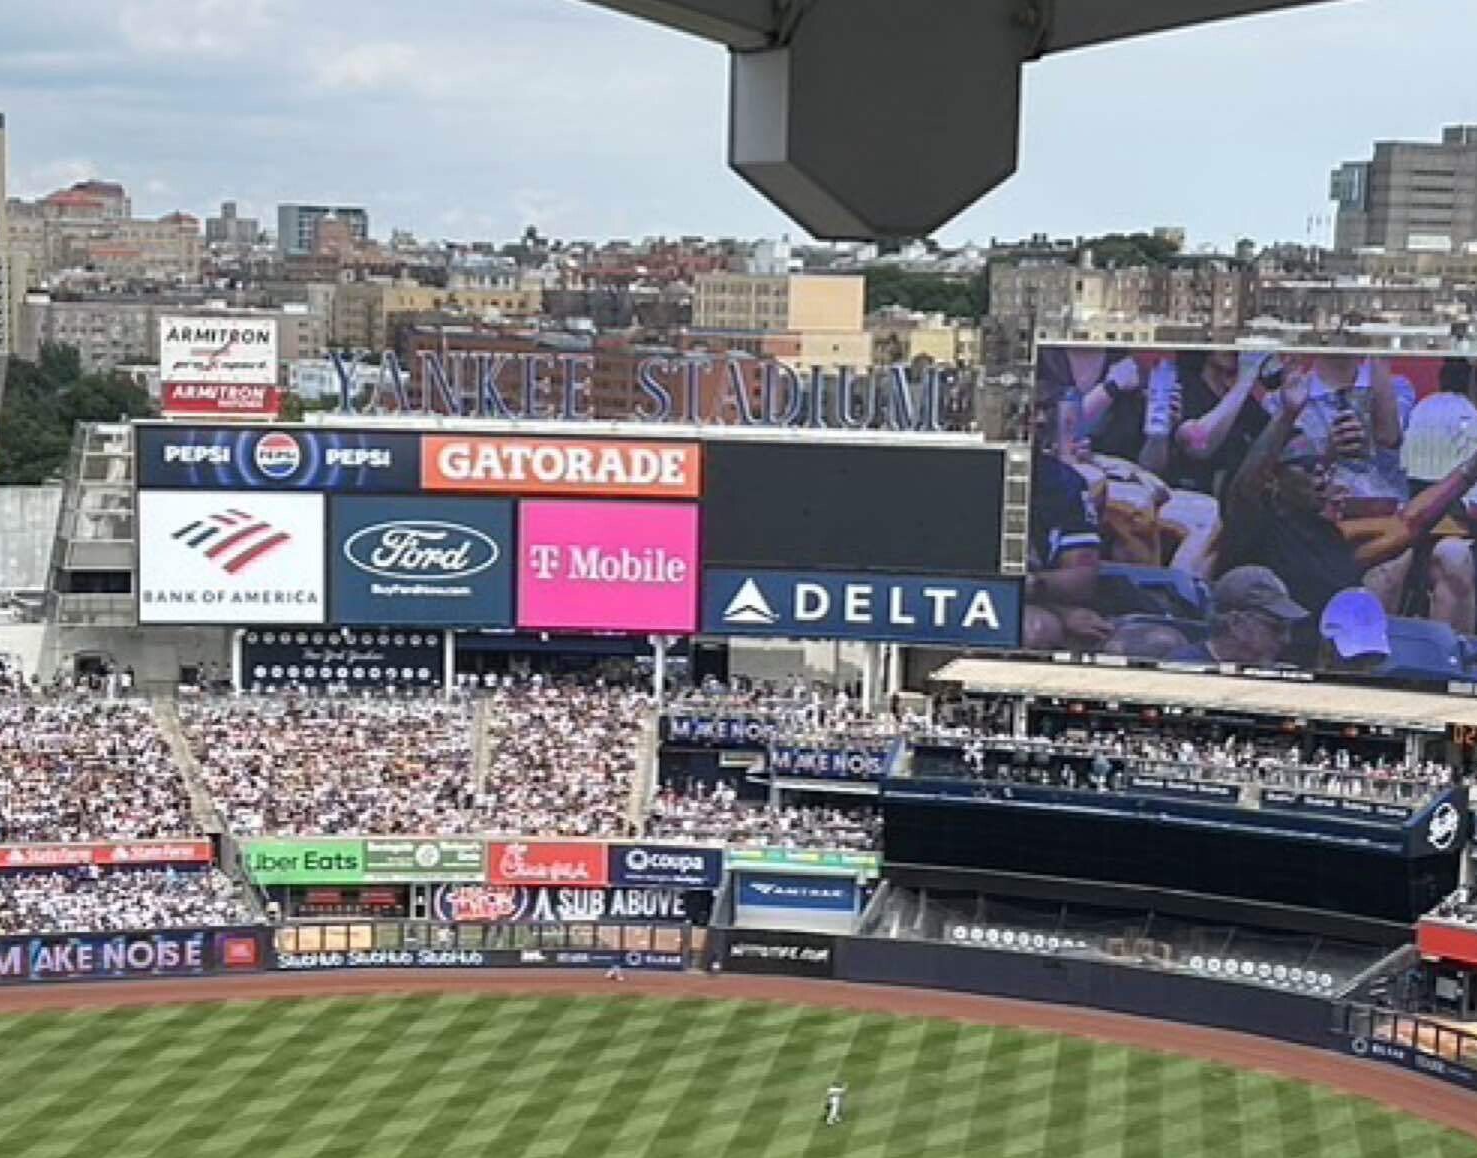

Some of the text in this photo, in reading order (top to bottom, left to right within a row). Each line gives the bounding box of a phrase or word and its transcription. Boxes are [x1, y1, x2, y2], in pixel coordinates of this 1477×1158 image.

[167, 327, 270, 345] ARMITRON
[173, 384, 266, 400] ARMITRON
[322, 347, 957, 430] YANKEE STADIUM
[164, 445, 231, 463] PEPSI
[326, 448, 390, 467] PEPSI
[438, 442, 685, 486] GATORADE
[372, 529, 472, 570] Ford
[569, 548, 686, 582] Mobile
[143, 589, 319, 604] BANK OF AMERICA
[793, 583, 1000, 630] DELTA
[303, 850, 358, 871] Eats
[646, 854, 704, 873] coupa
[532, 888, 555, 919] A
[557, 888, 605, 918] SUB
[610, 888, 686, 917] ABOVE
[102, 931, 204, 975] NOISE
